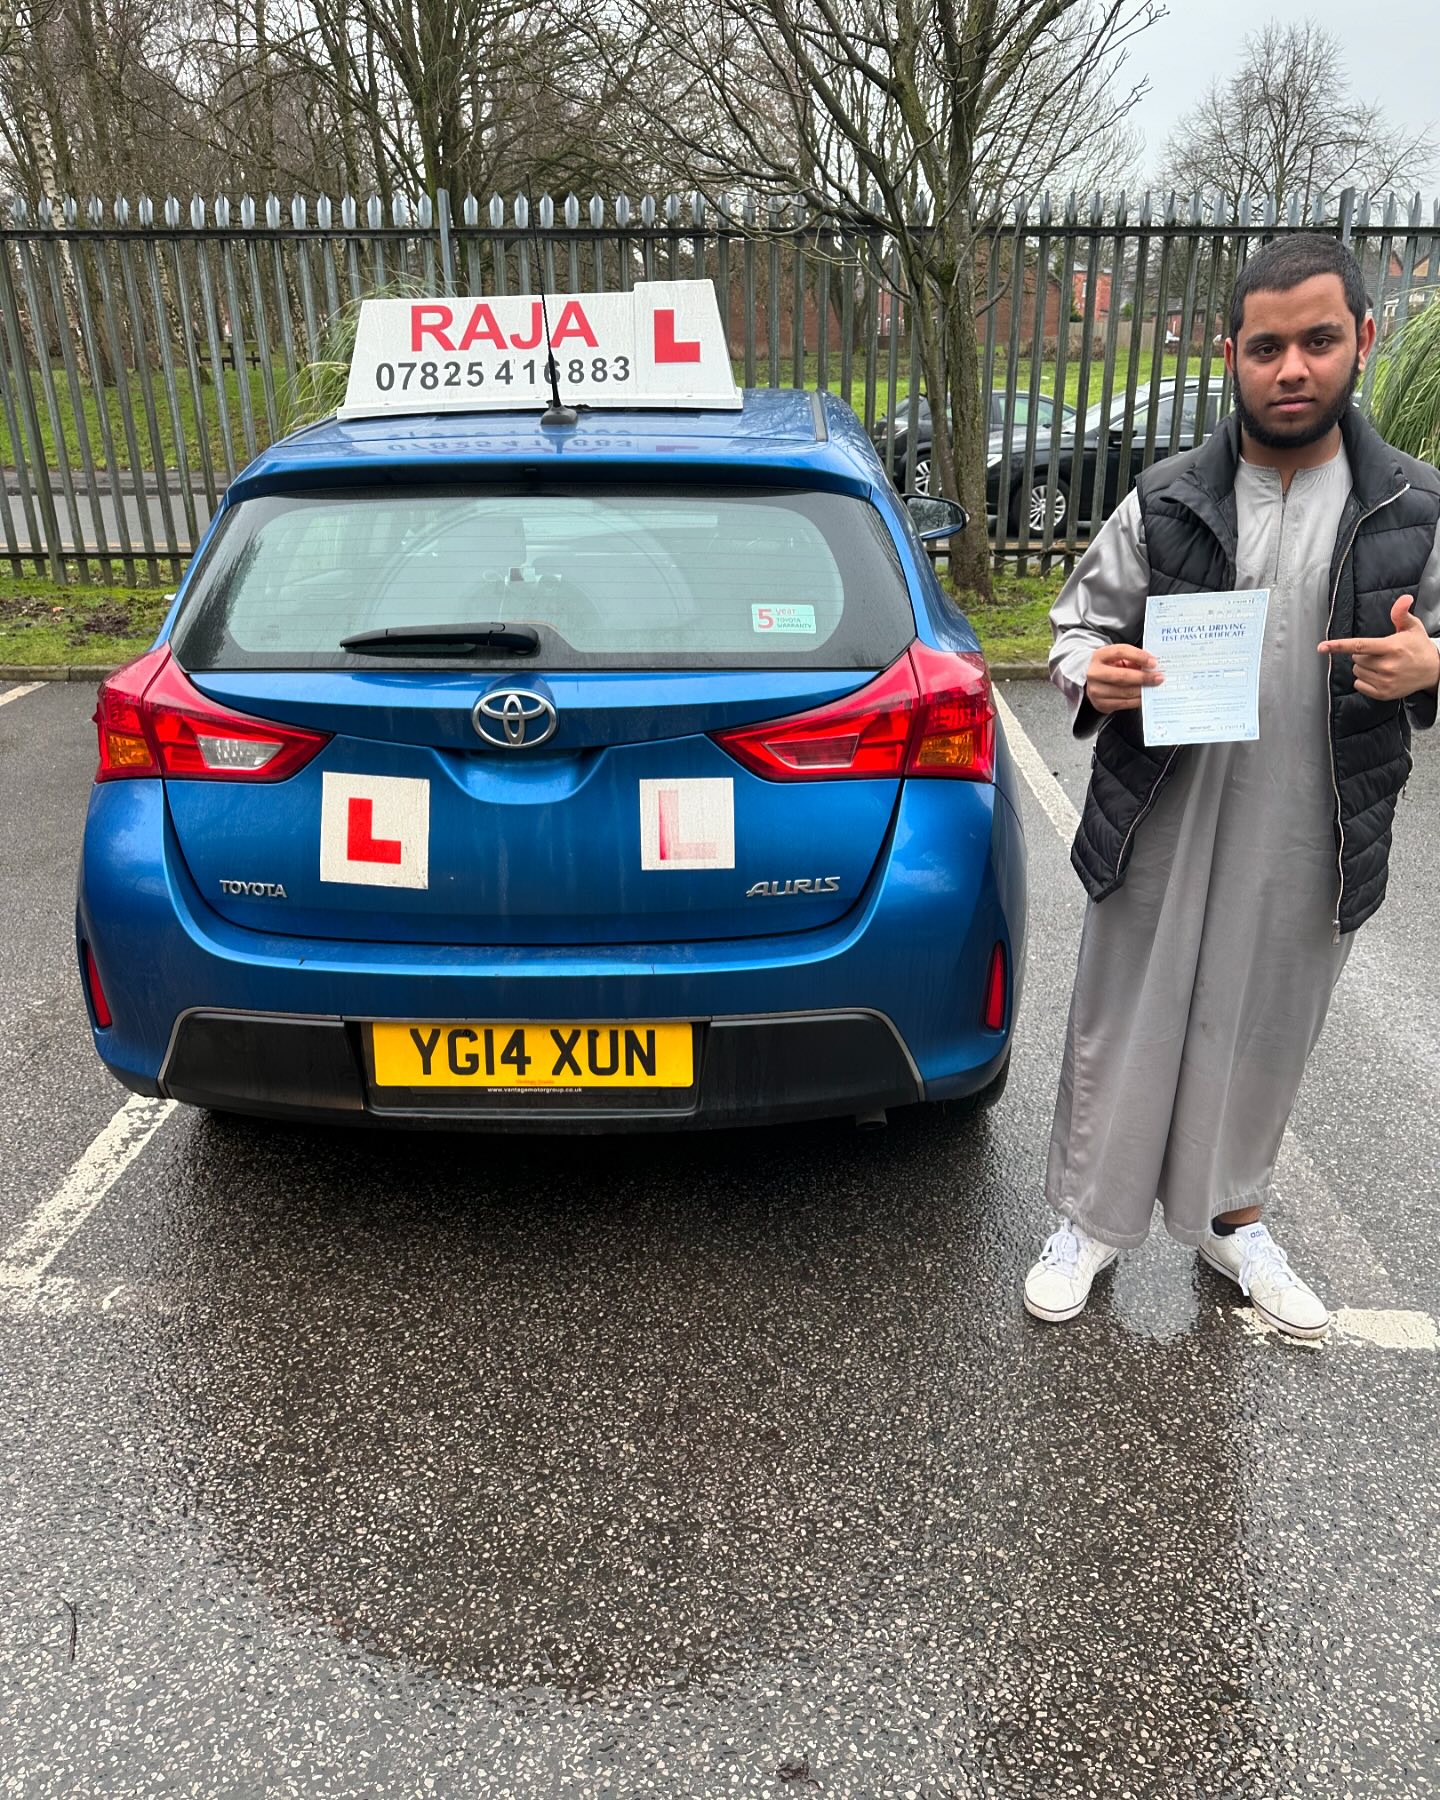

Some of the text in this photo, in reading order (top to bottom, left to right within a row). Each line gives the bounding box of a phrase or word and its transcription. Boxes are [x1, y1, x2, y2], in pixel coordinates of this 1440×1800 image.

[411, 301, 599, 352] RAJA
[654, 309, 701, 363] L
[376, 356, 630, 391] 07825 416883
[758, 608, 774, 629] 5
[1161, 623, 1246, 634] PRACTICAL DRIVING
[1199, 631, 1245, 639] CERTIFICATE
[347, 797, 402, 865] L
[658, 790, 717, 861] L
[219, 880, 287, 898] TOYOTA
[745, 876, 841, 897] AURIS
[409, 1028, 656, 1077] YG14 XUN
